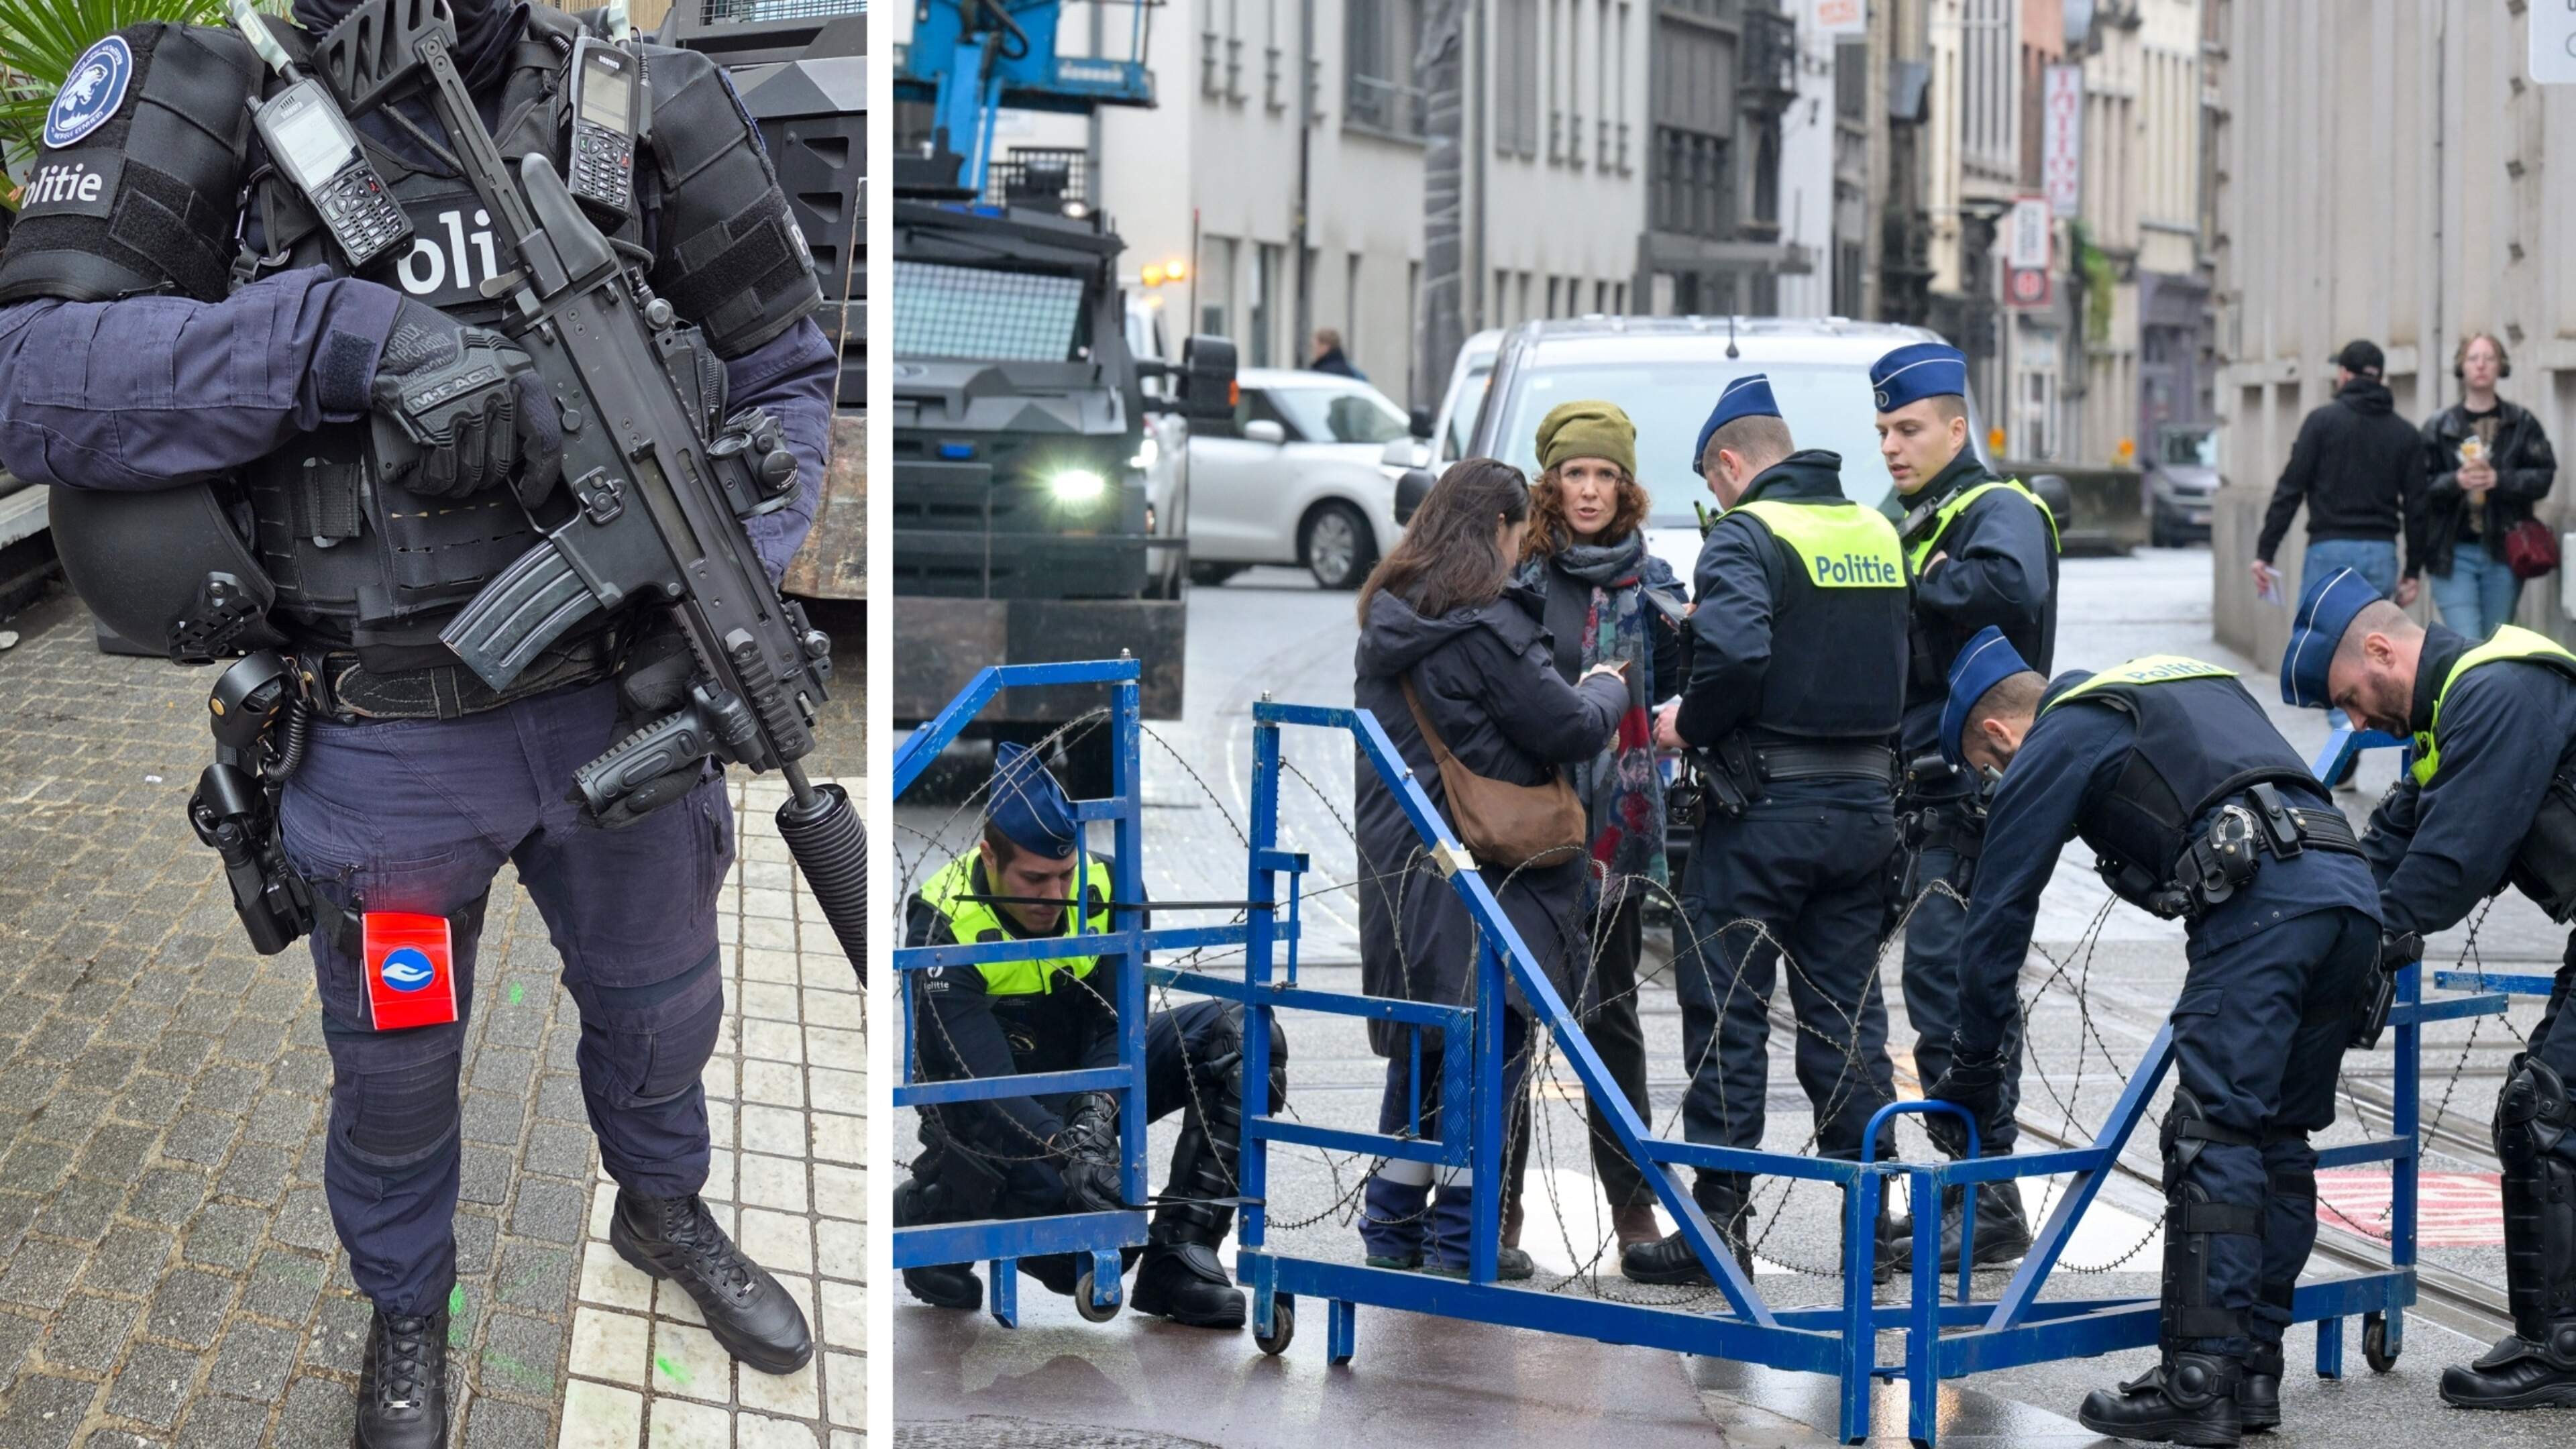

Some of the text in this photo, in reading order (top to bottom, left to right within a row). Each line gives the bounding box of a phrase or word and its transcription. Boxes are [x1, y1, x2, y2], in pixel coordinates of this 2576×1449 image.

[21, 163, 103, 209] olitie
[397, 209, 498, 294] oli
[1815, 553, 1896, 583] Politie
